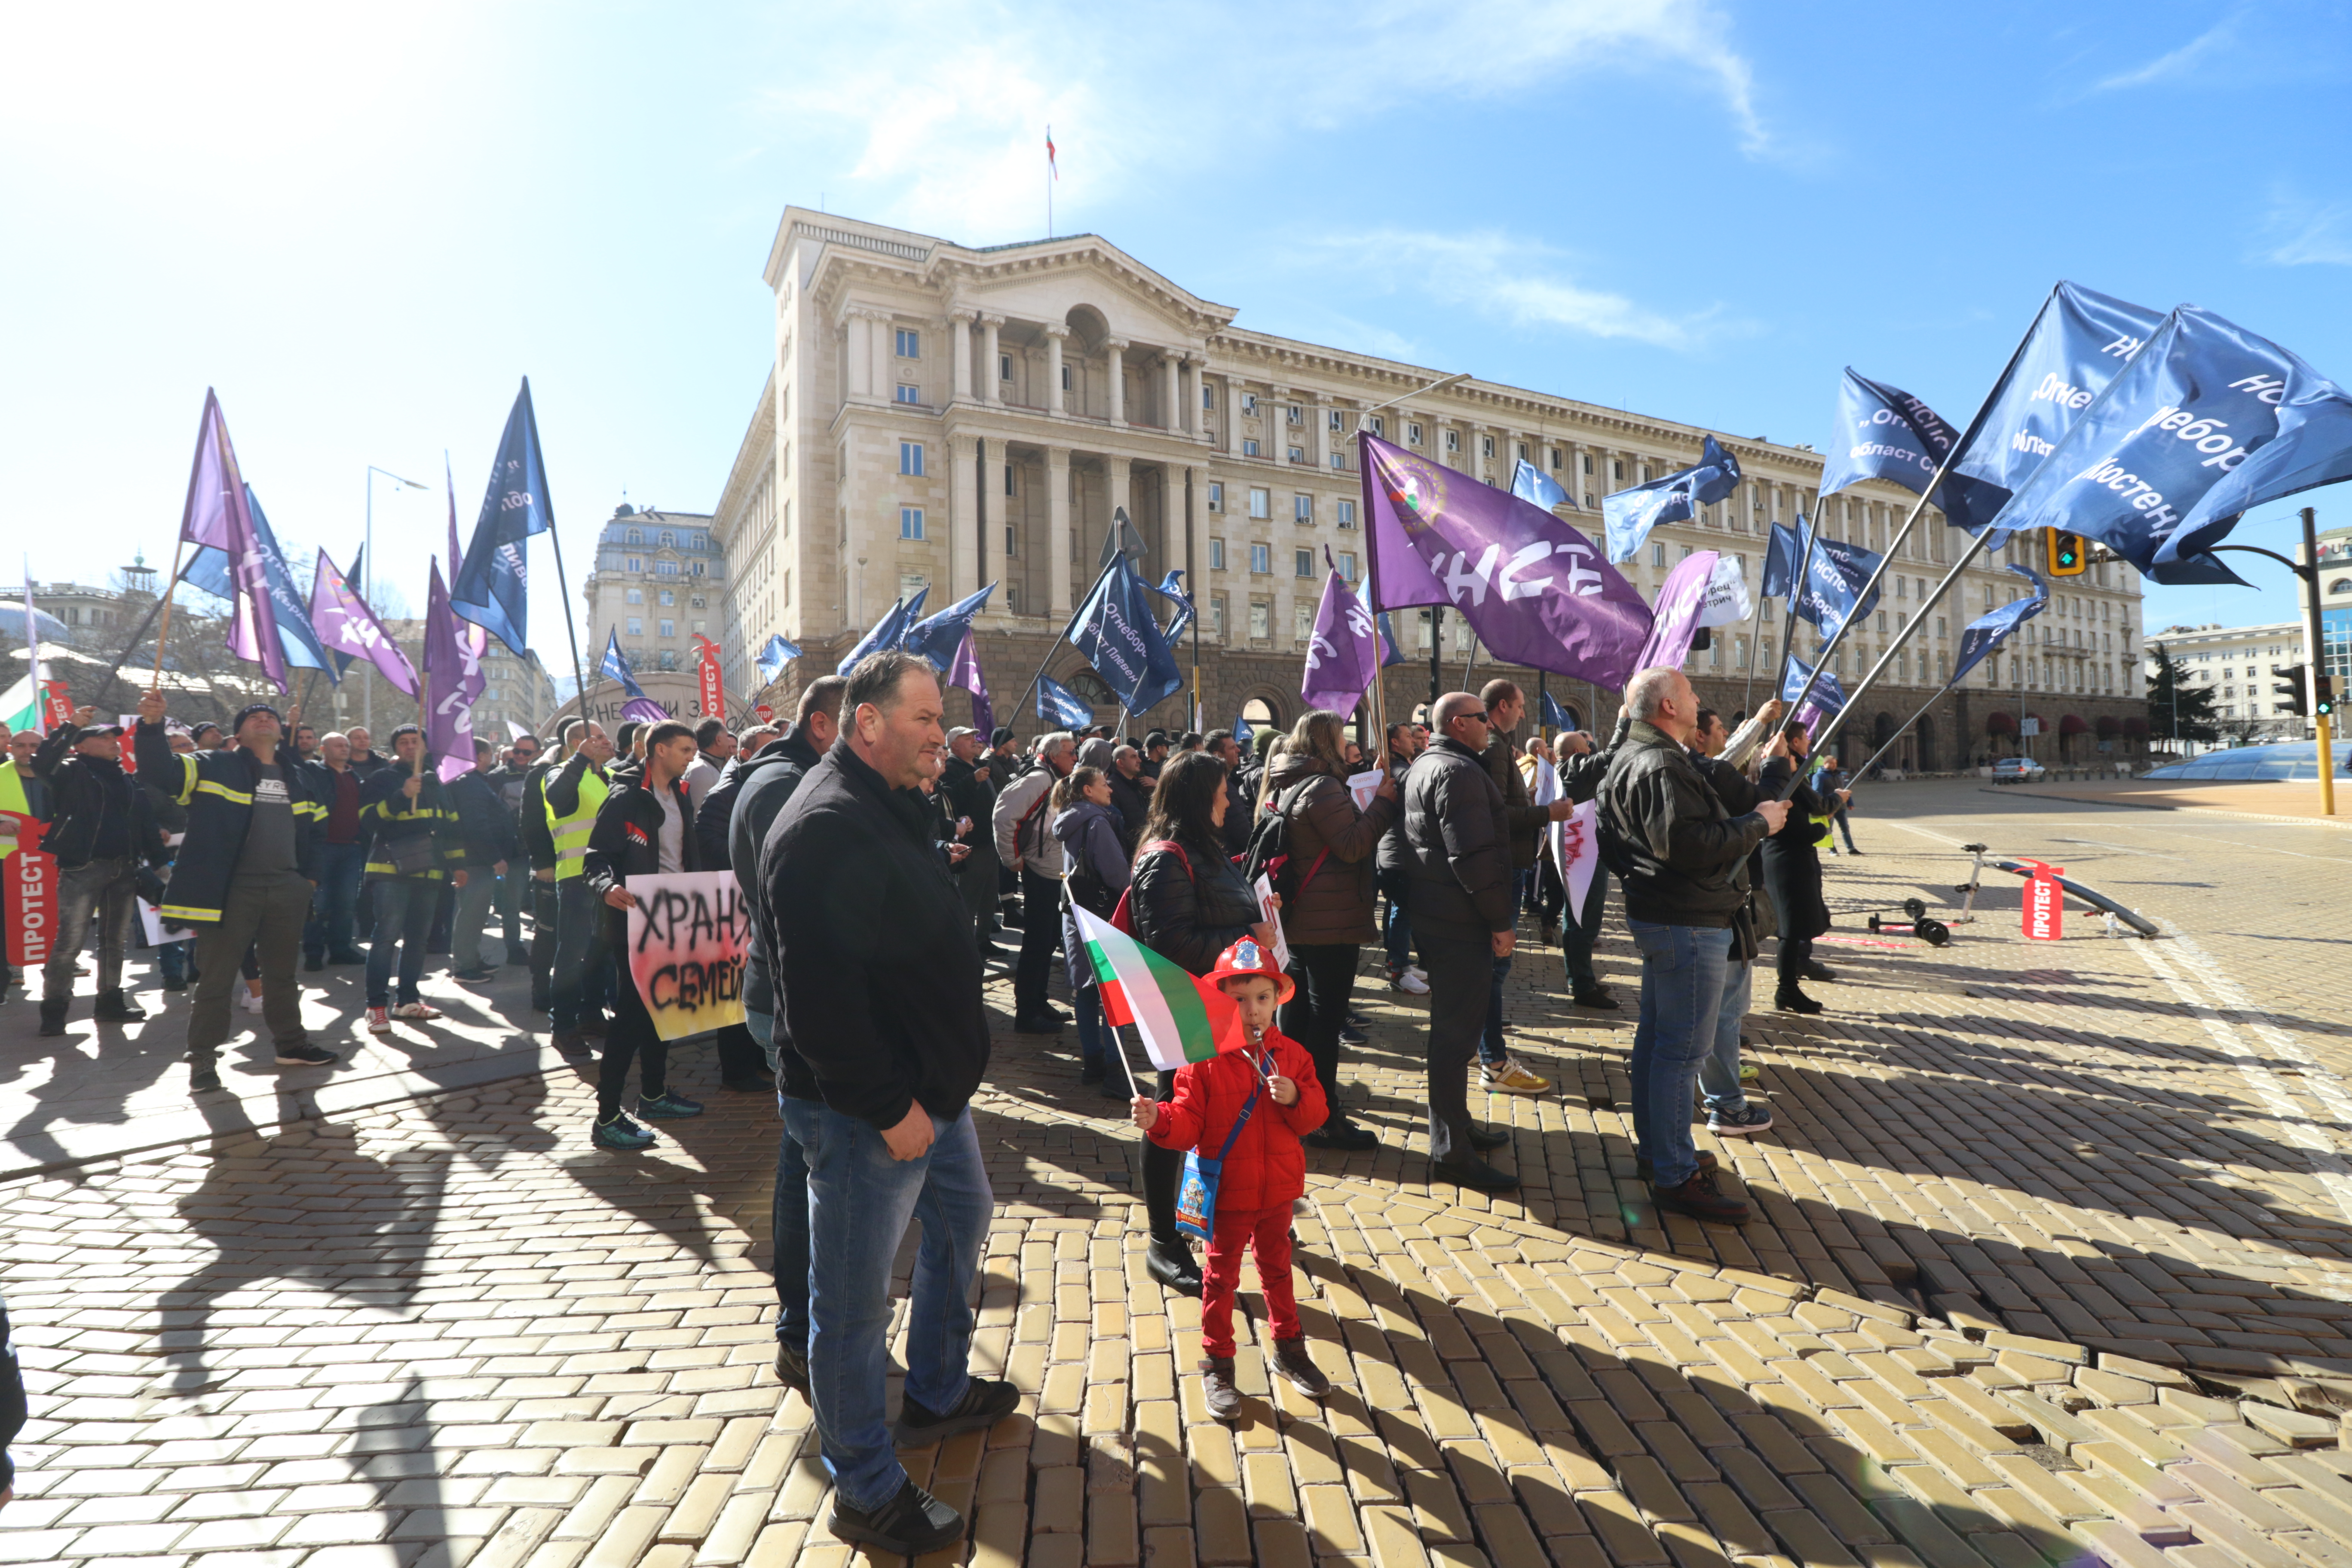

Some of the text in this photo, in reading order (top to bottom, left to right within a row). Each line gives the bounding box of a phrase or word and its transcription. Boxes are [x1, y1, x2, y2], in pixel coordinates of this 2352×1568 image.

[1850, 441, 1916, 462] област
[1813, 558, 1847, 593] НСПС
[1105, 646, 1138, 683] Плевен
[20, 852, 46, 961] ПРОТЕСТ
[2033, 879, 2051, 938] ПРОТЕСТ
[1188, 1216, 1200, 1225] POLICE
